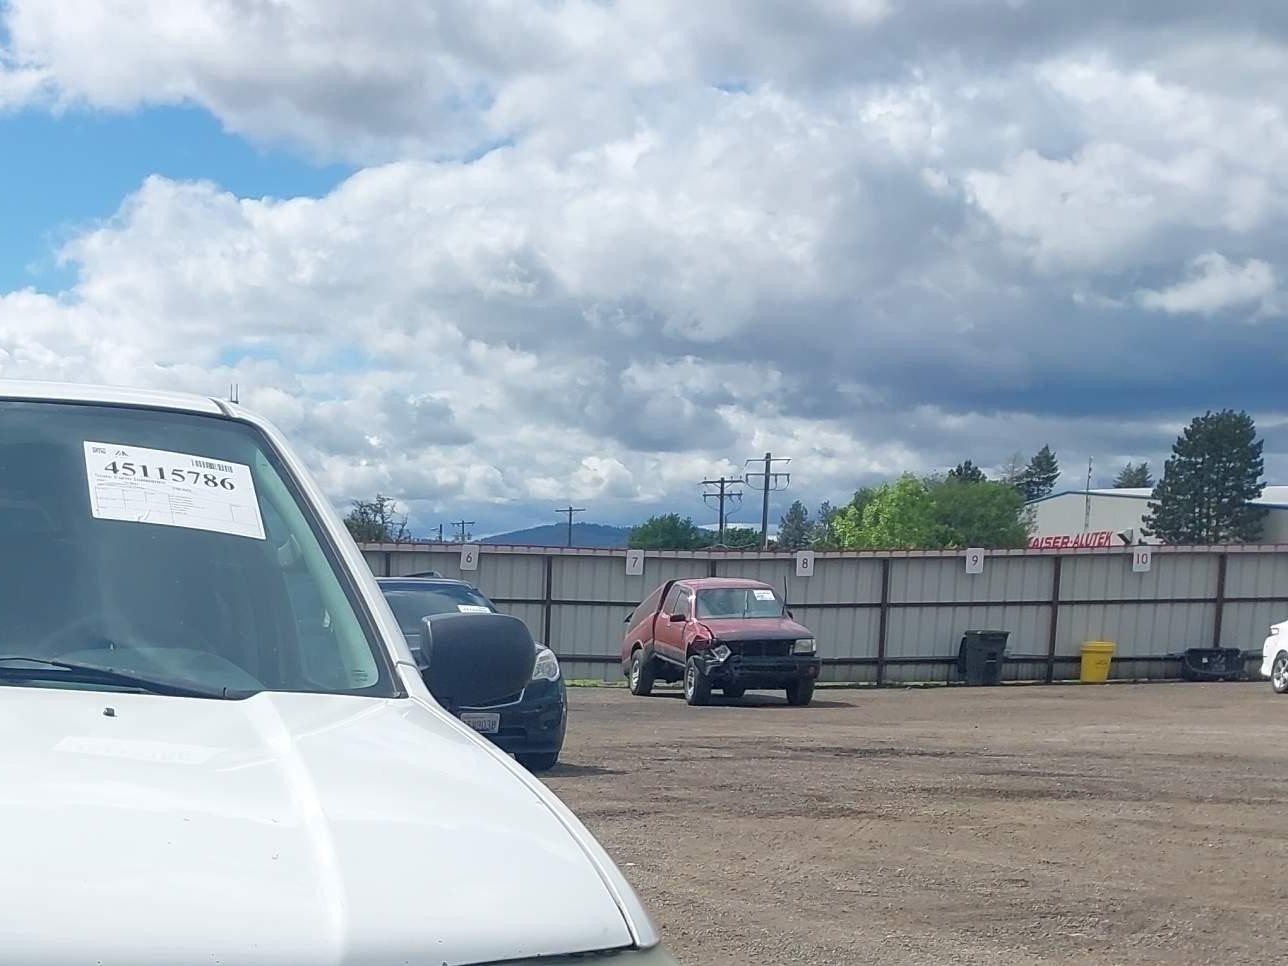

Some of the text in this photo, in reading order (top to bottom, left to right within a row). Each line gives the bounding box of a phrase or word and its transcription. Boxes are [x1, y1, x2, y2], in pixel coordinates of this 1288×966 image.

[104, 461, 235, 491] 45115786
[466, 552, 472, 563] 6
[632, 557, 638, 568] 7
[972, 555, 978, 566] 9
[1136, 553, 1148, 565] 10
[802, 558, 808, 569] 8
